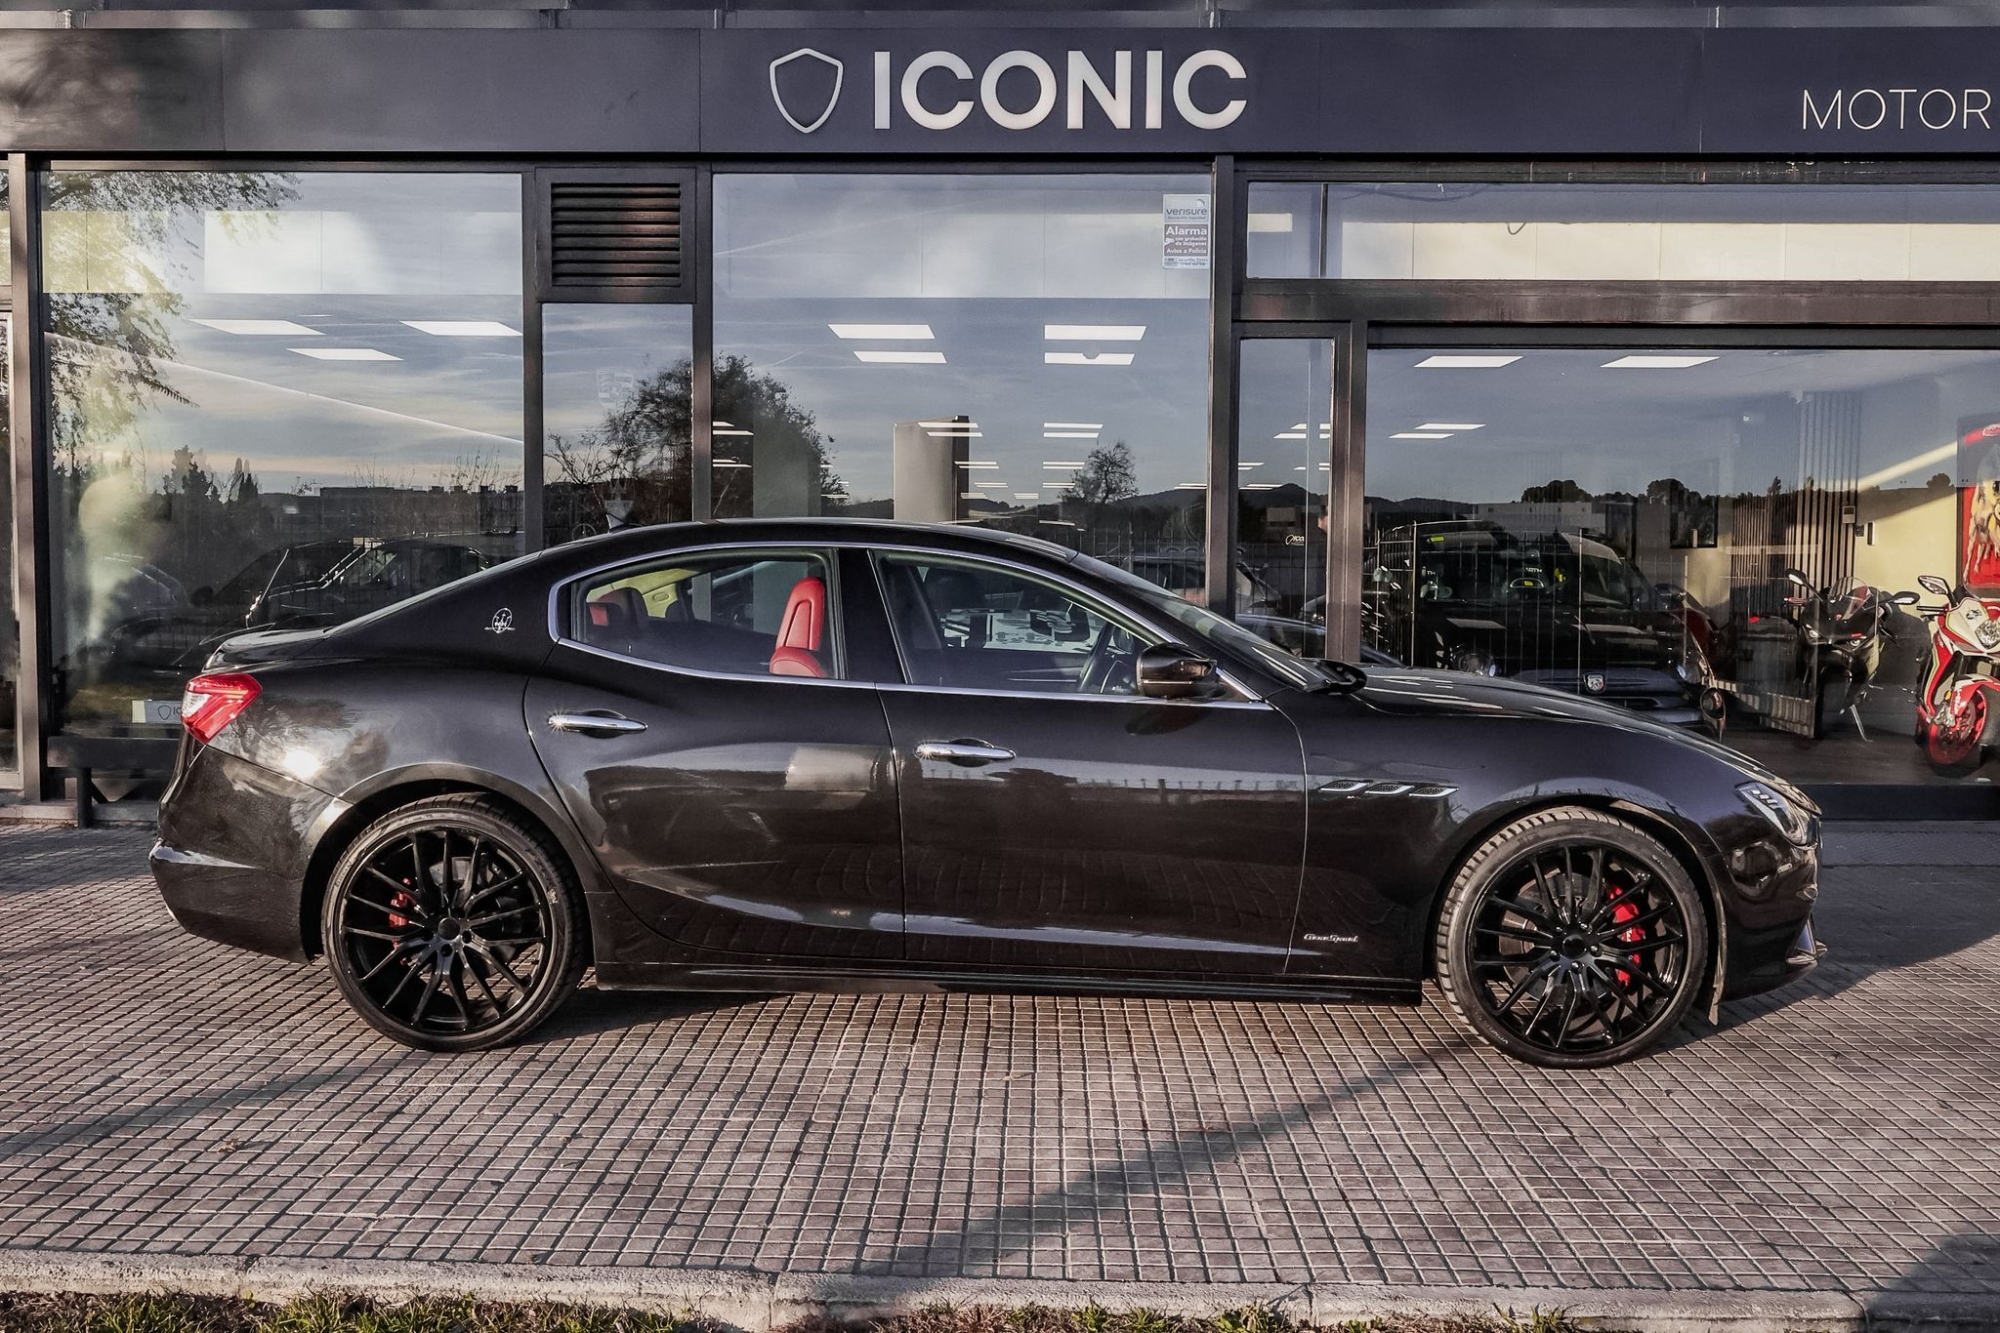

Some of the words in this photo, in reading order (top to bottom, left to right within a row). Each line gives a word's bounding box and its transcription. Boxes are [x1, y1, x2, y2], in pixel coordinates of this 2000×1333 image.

[874, 49, 1248, 131] ICONIC
[1802, 88, 1992, 131] MOTOR
[1166, 207, 1208, 216] verisure
[1166, 226, 1207, 235] Alarma
